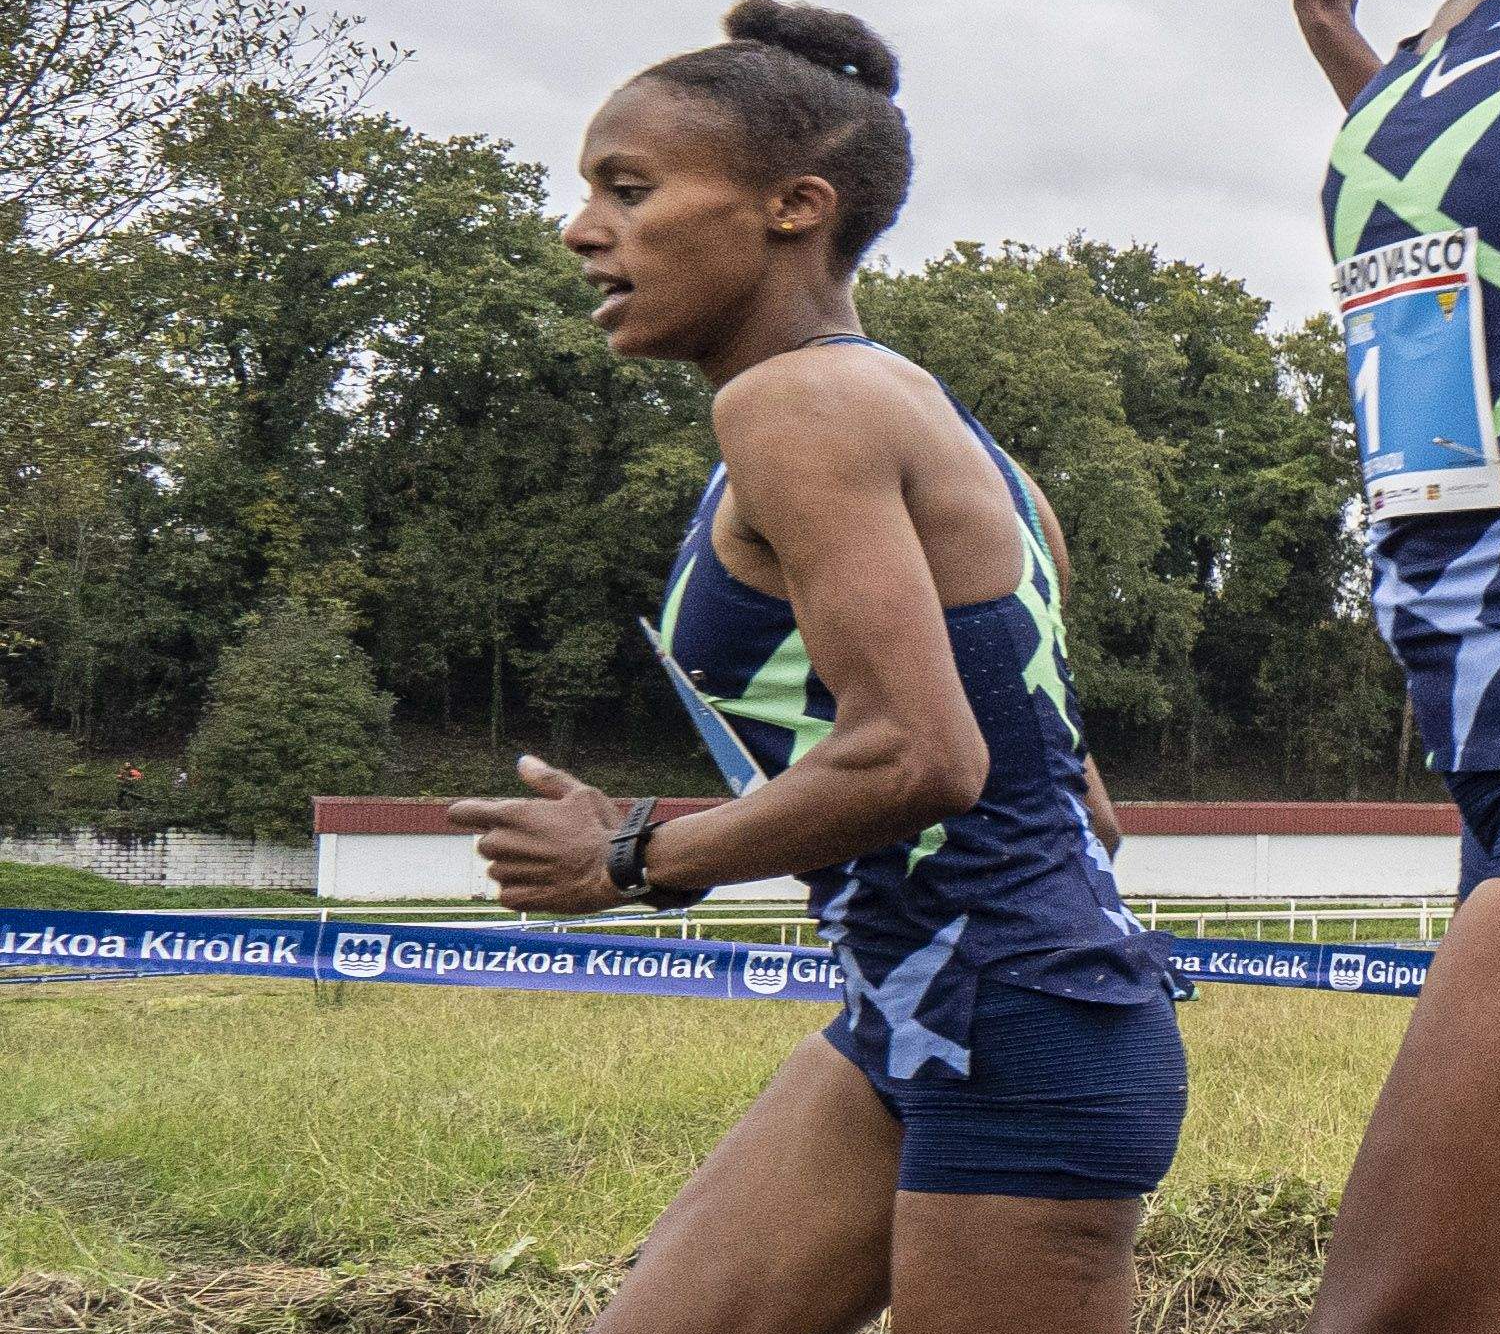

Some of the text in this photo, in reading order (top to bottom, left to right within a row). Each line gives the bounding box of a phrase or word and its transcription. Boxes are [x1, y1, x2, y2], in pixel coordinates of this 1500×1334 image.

[1383, 234, 1466, 284] VASCO
[0, 926, 299, 965] uzkoa Kirolak
[392, 941, 716, 979] Gipuzkoa Kirolak
[1209, 952, 1307, 979] Kirolak
[1366, 960, 1426, 988] Gipu
